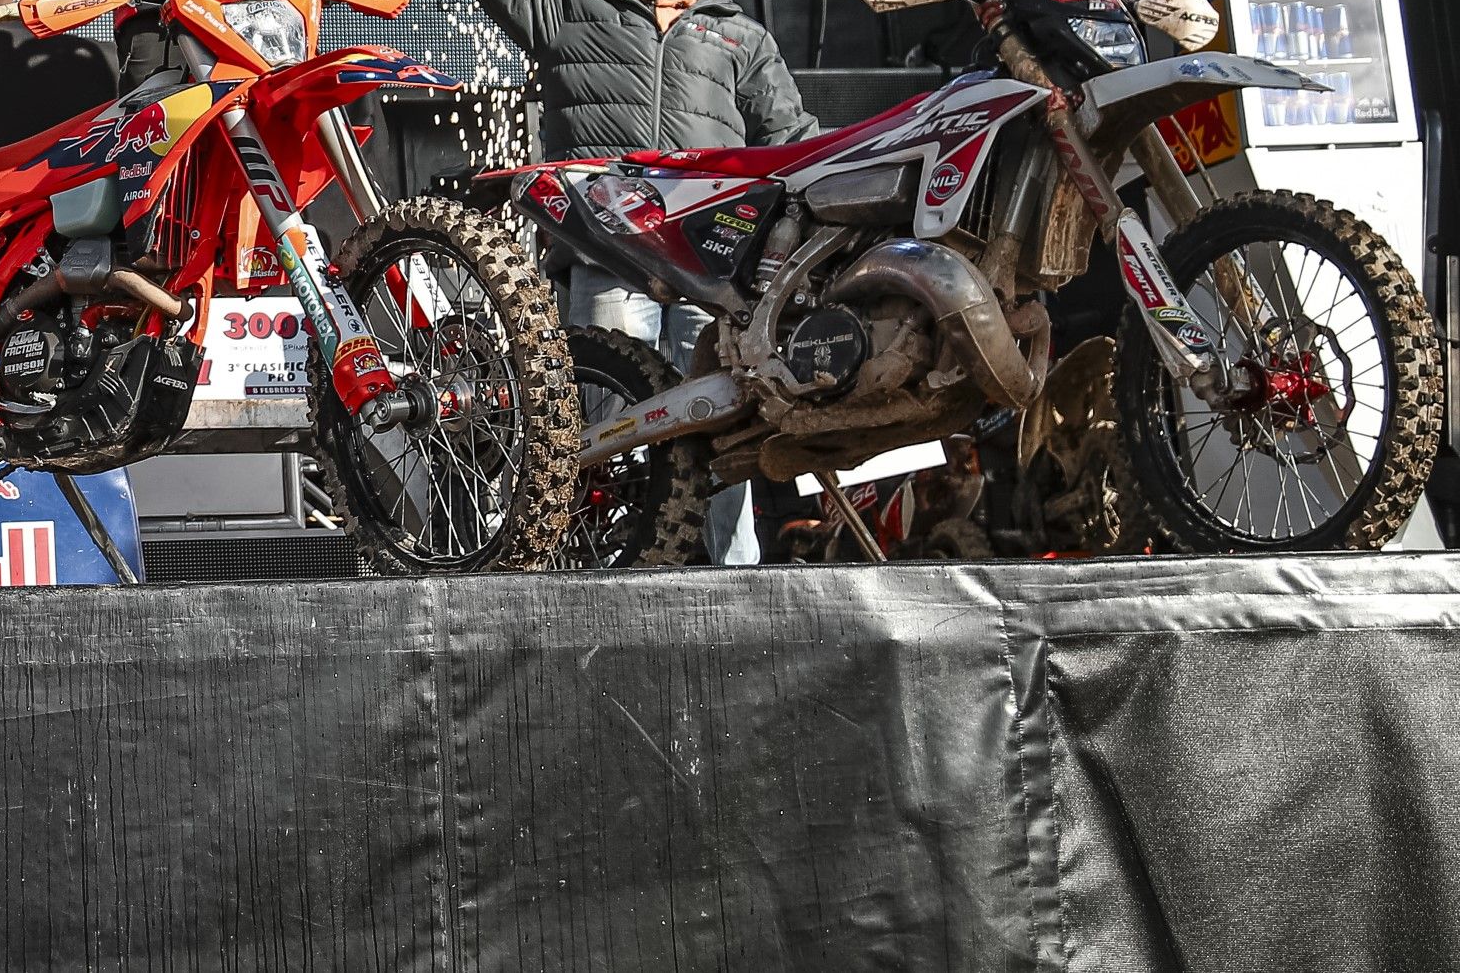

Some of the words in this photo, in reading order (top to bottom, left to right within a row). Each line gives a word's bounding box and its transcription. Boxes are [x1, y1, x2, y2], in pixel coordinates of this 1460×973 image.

[928, 174, 962, 188] NILS
[123, 189, 152, 202] AIROH
[290, 267, 338, 346] MOTOREX
[8, 329, 40, 347] KTM
[790, 333, 854, 349] REKLUSE
[4, 340, 45, 358] FACTORY
[4, 358, 45, 372] HINSON
[153, 375, 189, 390] ACERBIS
[267, 373, 296, 383] PRO
[259, 387, 296, 395] FEBRERO
